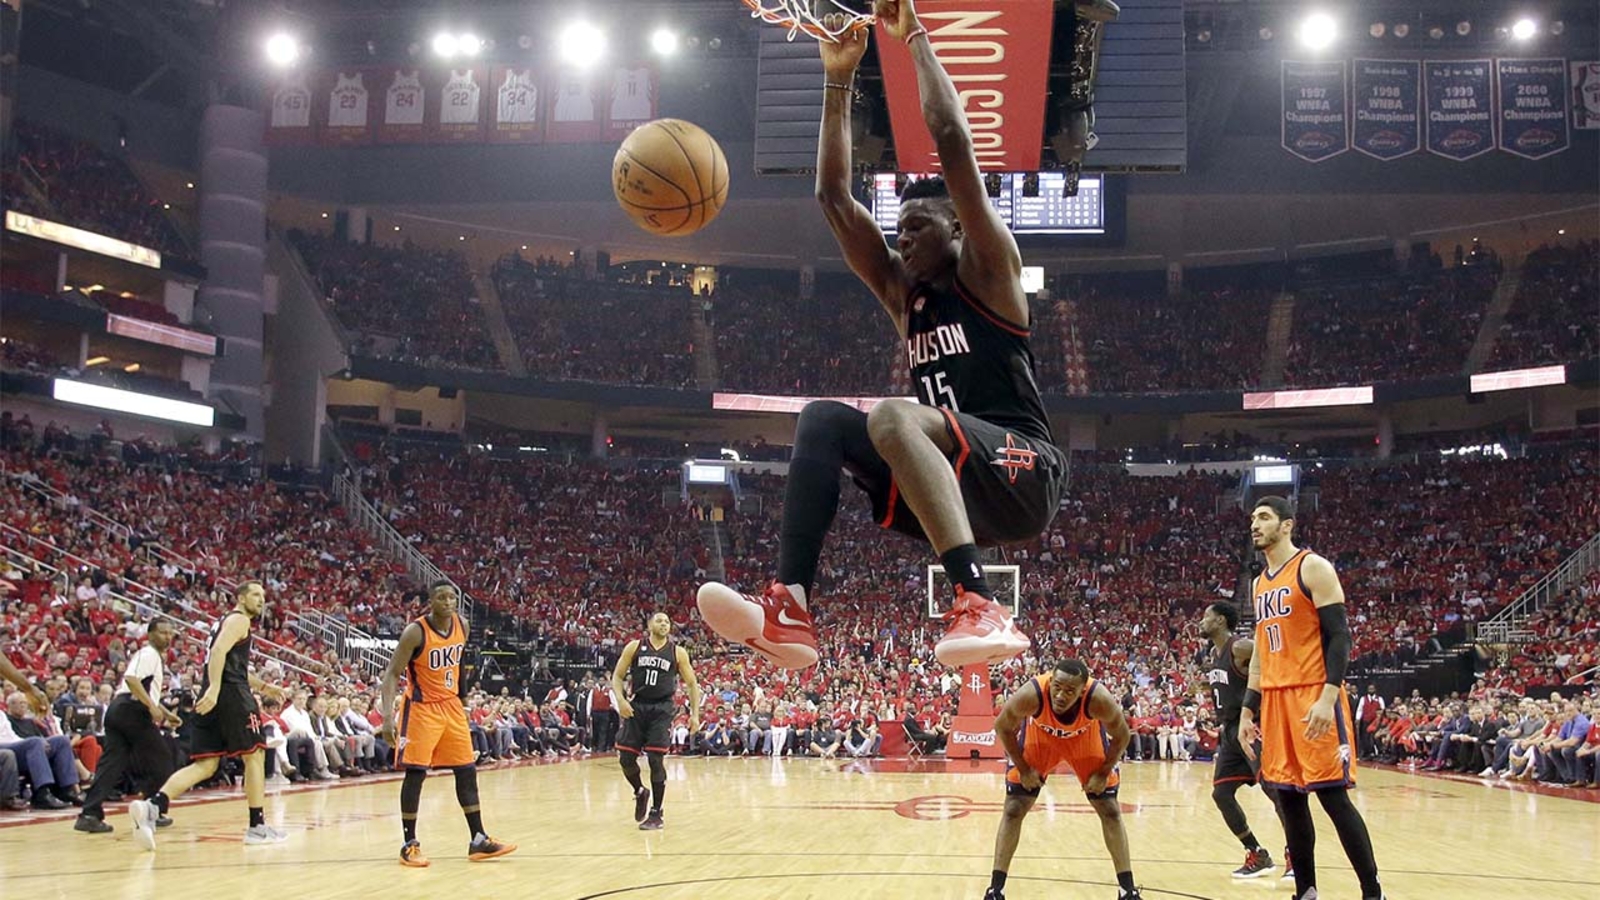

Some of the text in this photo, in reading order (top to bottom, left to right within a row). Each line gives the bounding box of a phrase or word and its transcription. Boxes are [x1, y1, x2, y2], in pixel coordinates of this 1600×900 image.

[1300, 88, 1326, 98] 1997
[1373, 86, 1400, 97] 1998
[1445, 86, 1474, 97] 1999
[1517, 85, 1548, 96] 2000
[340, 95, 356, 109] 23
[396, 93, 414, 107] 24
[451, 91, 469, 106] 22
[508, 91, 526, 105] 34
[1296, 99, 1330, 110] WNBA
[1369, 98, 1403, 109] WNBA
[1441, 98, 1477, 109] WNBA
[1515, 97, 1551, 107] WNBA
[1286, 111, 1342, 124] Champions
[1358, 110, 1415, 123] Champions
[1430, 110, 1489, 123] Champions
[1503, 109, 1564, 122] Champions
[920, 371, 959, 414] 15
[1265, 623, 1282, 653] 11
[638, 655, 671, 672] HOUSTON
[644, 668, 659, 686] 10
